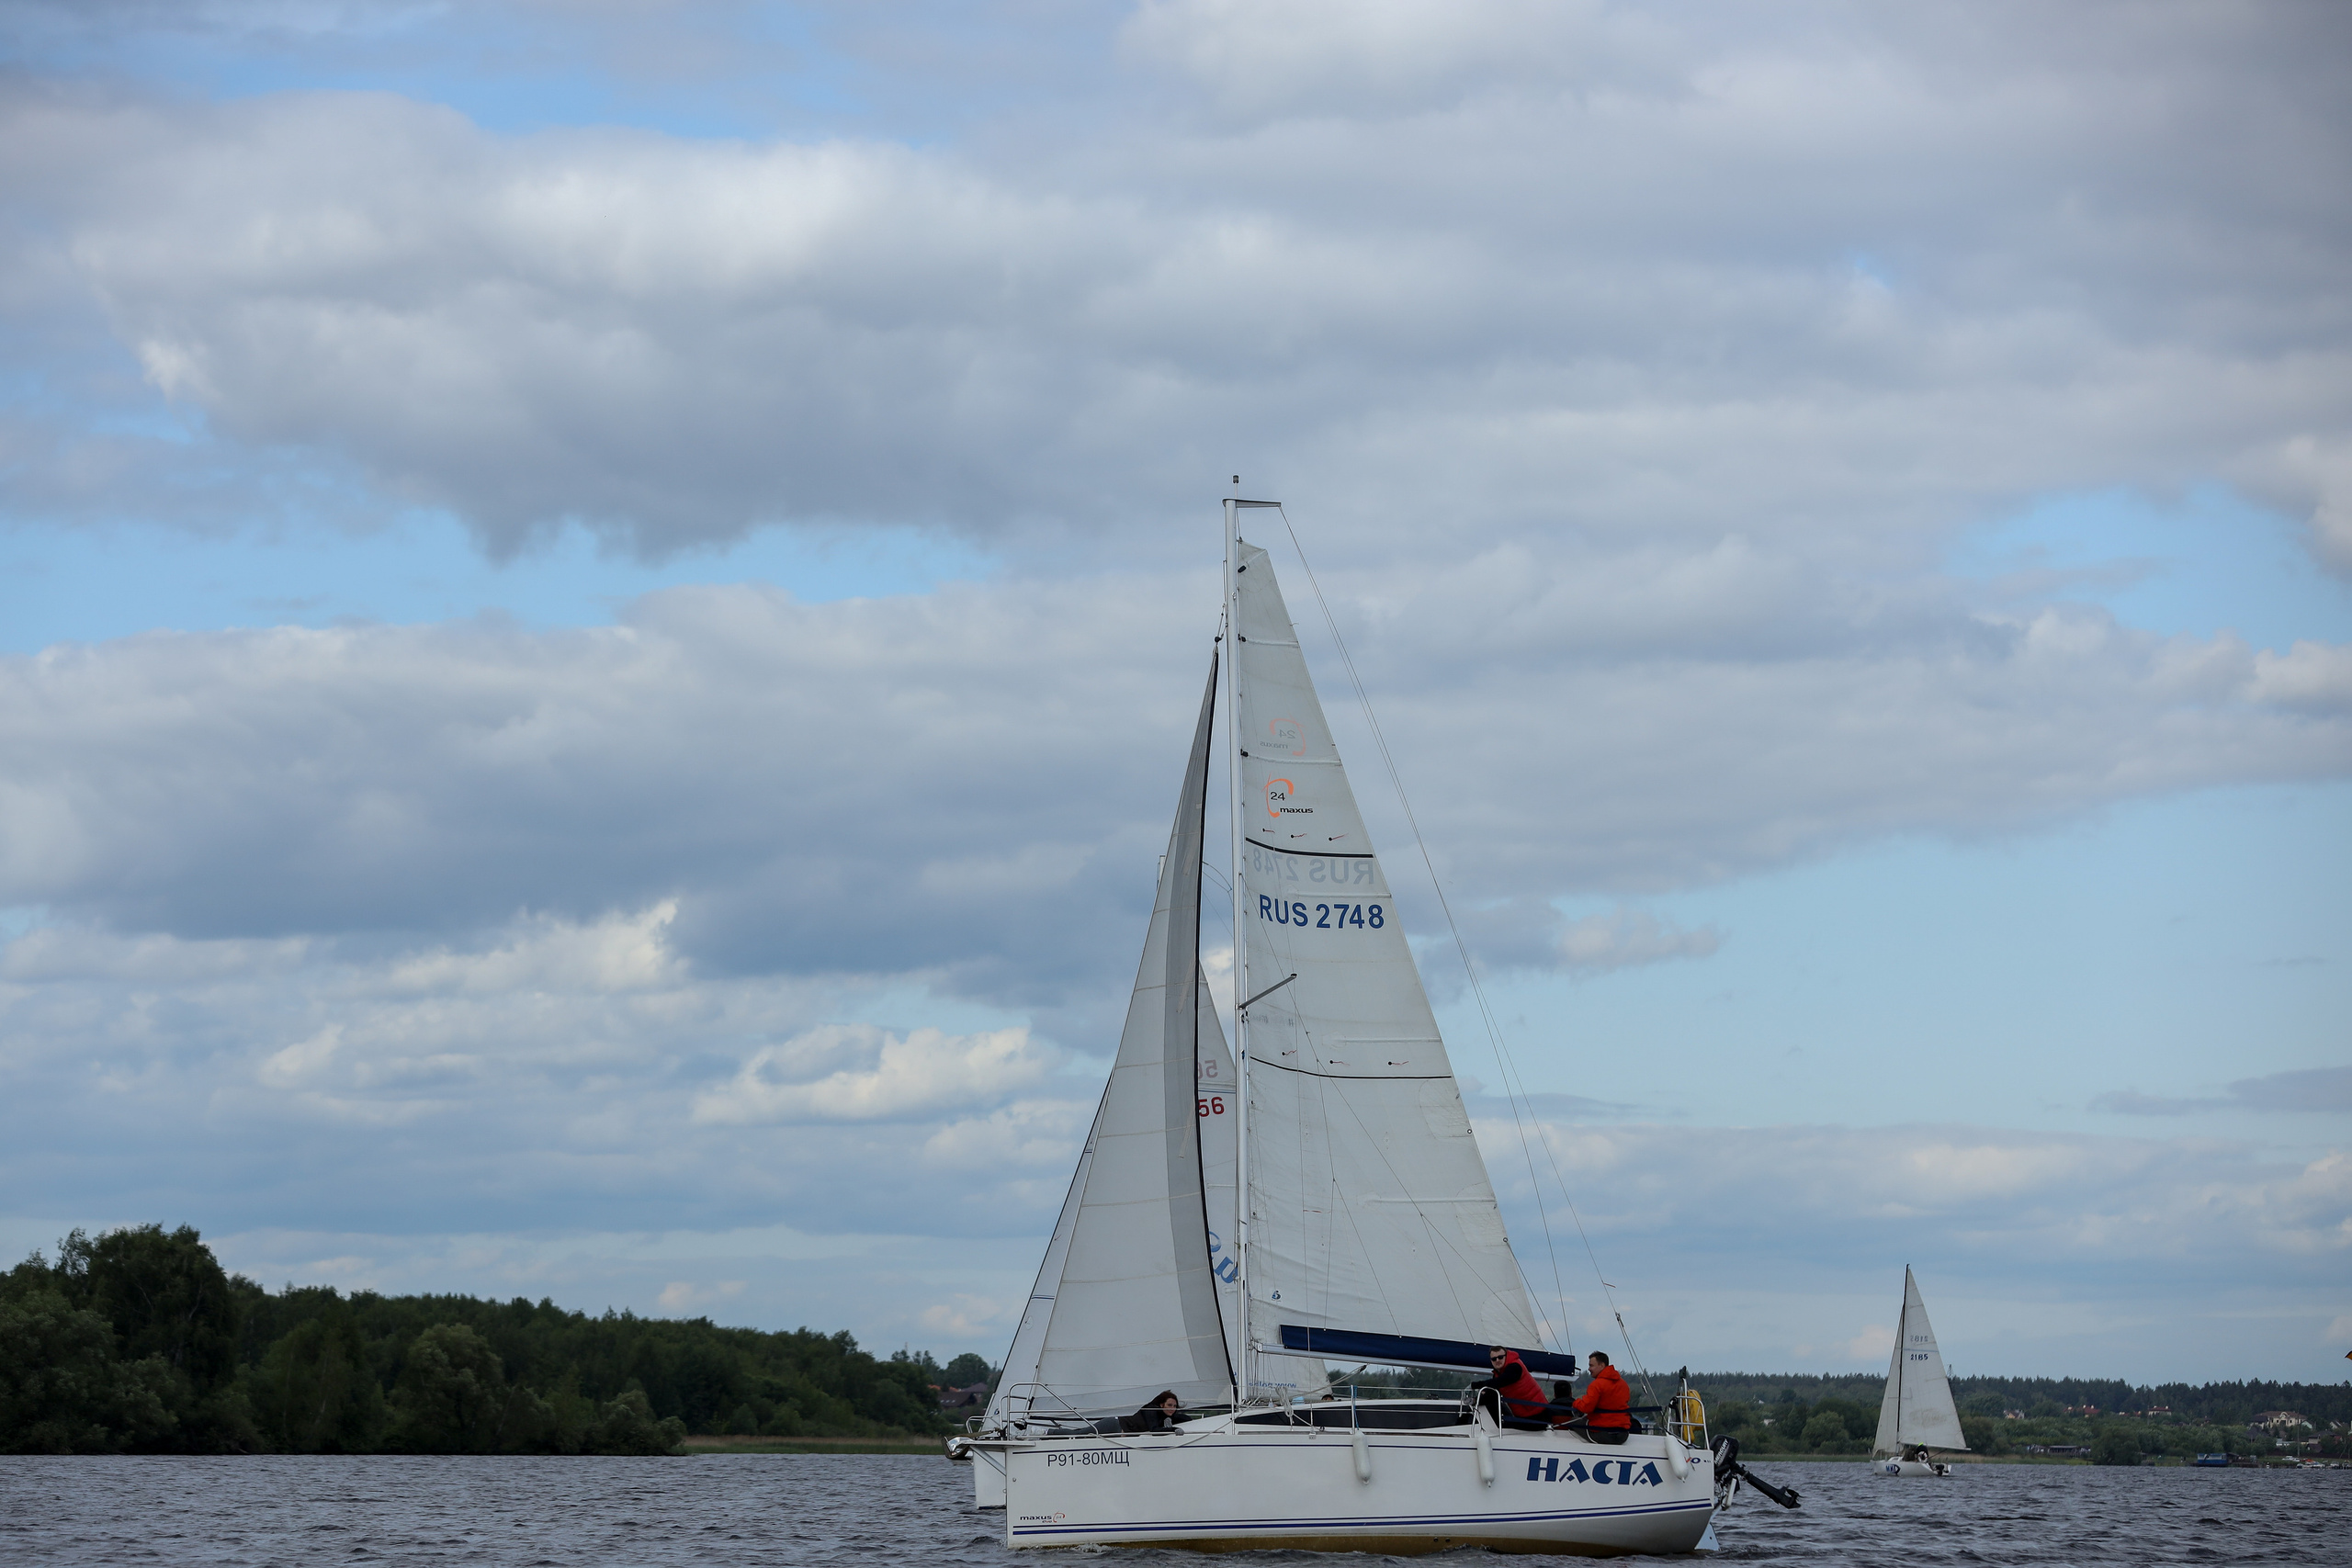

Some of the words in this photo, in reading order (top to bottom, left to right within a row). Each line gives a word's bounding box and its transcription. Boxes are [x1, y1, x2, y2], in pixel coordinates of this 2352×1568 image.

[1270, 791, 1285, 801] 24
[1260, 894, 1308, 927] RUS
[1316, 904, 1385, 929] 2748
[1198, 1096, 1225, 1117] 56
[1047, 1450, 1130, 1467] Р91-80МЩ
[1526, 1457, 1664, 1487] НАСТА
